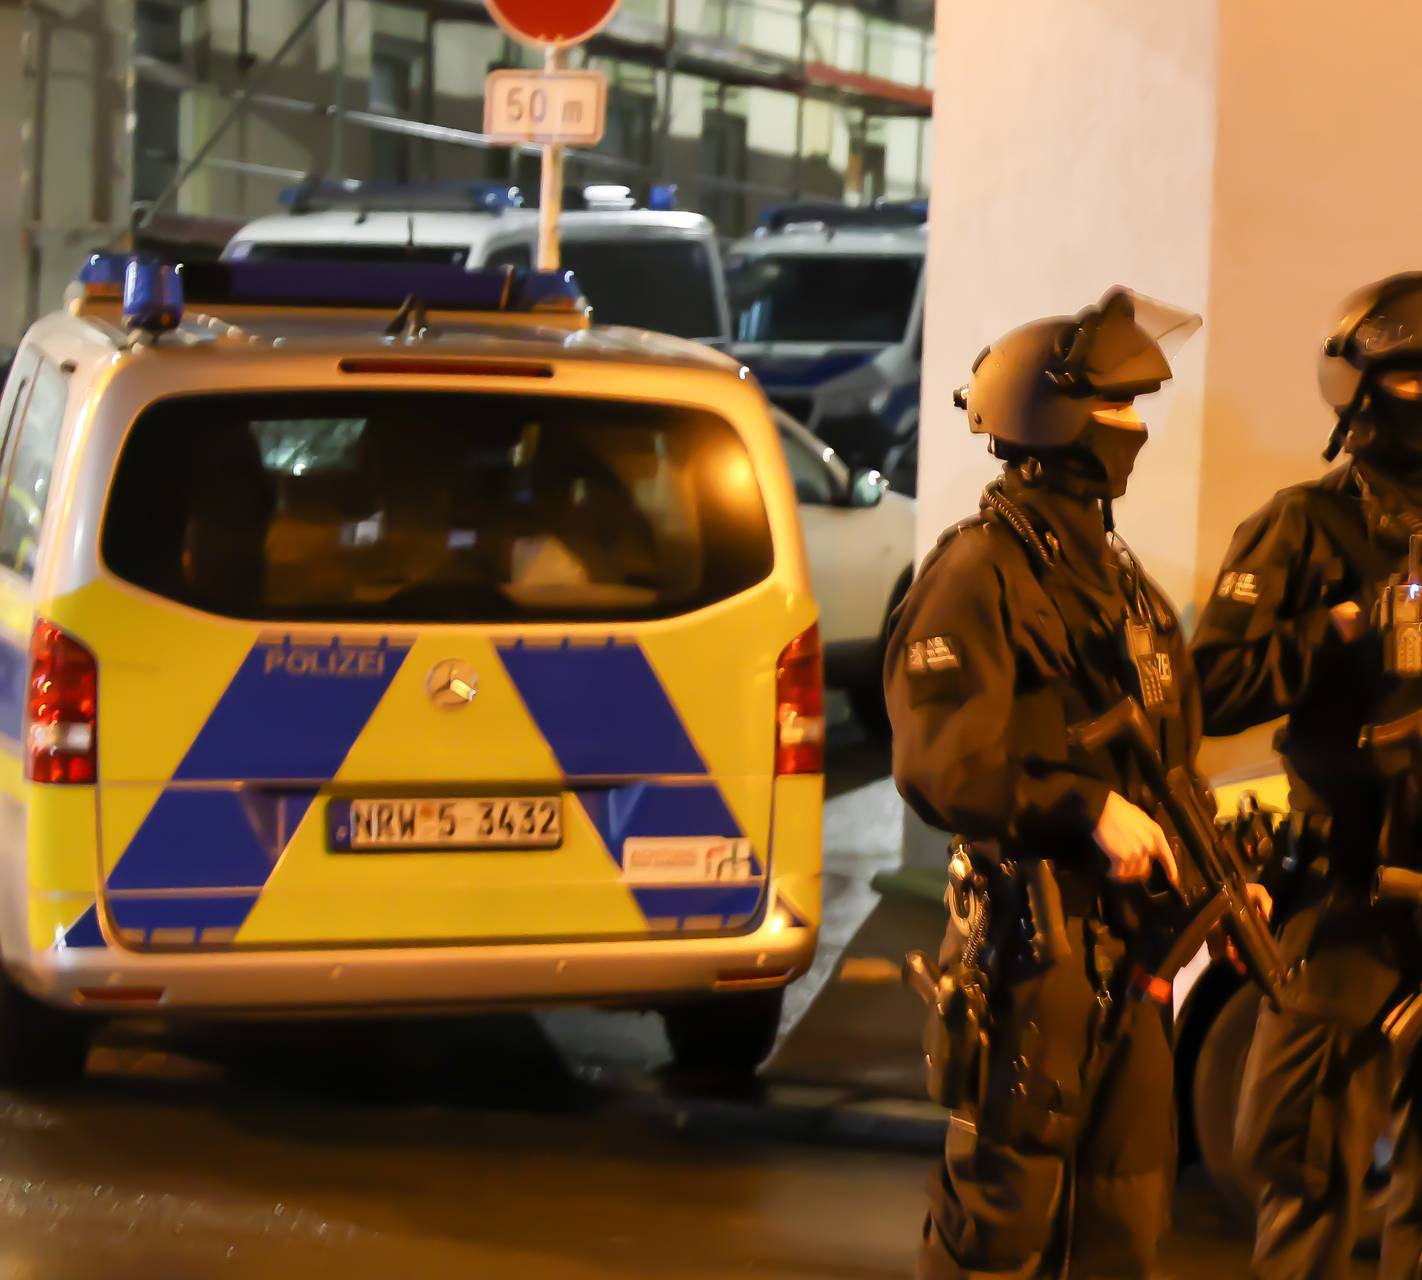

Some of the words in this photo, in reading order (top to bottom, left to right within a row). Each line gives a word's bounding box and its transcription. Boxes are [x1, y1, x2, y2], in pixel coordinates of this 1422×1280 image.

[506, 87, 547, 123] 50
[561, 100, 583, 123] m
[263, 648, 386, 677] POLIZEI
[353, 801, 416, 840] NRW
